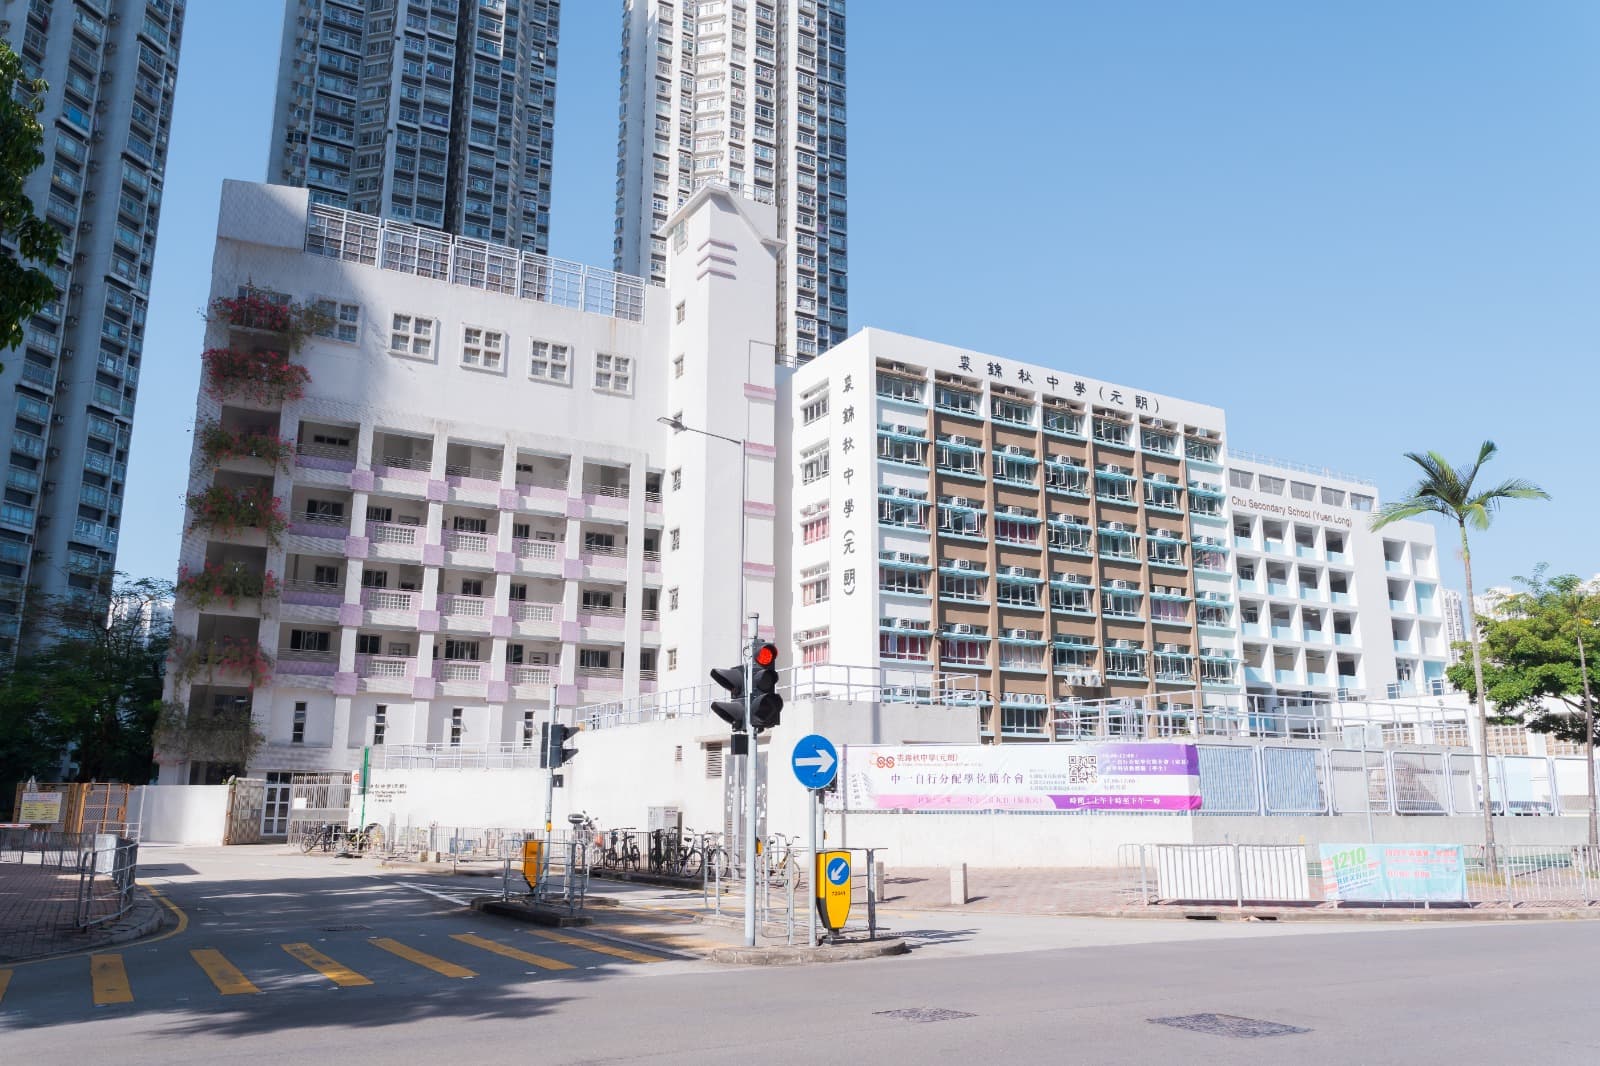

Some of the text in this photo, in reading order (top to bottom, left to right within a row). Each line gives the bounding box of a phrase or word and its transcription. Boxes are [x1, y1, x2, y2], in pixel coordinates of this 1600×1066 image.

[1231, 495, 1353, 528] Chu Secondary School (Yuen Long)
[891, 773, 1024, 785] 中一自行分配學位簡介會
[1332, 847, 1367, 870] 1210
